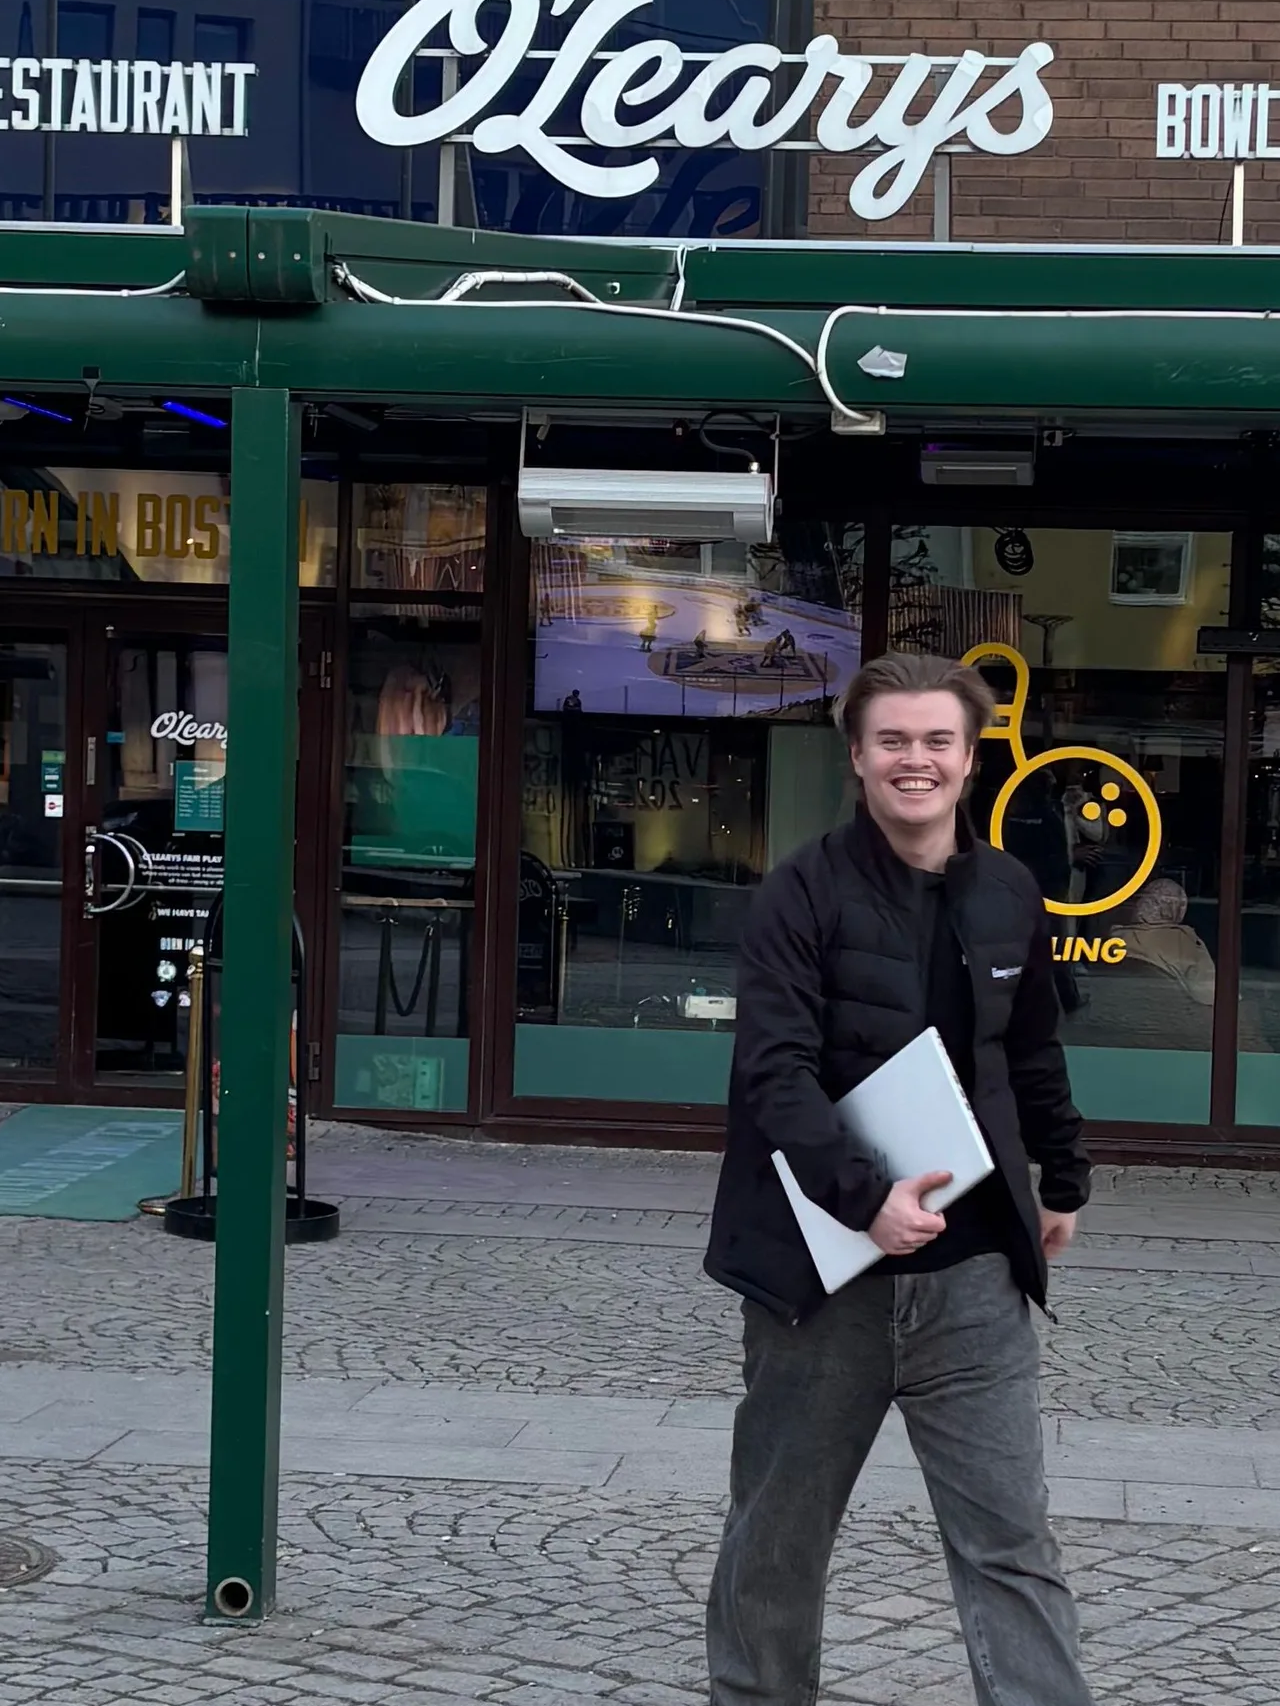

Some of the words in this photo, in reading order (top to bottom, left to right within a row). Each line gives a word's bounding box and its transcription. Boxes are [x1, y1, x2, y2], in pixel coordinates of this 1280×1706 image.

[75, 492, 120, 558] IN
[136, 494, 308, 562] BOS
[150, 710, 228, 749] O'Lear
[1051, 936, 1127, 964] LING
